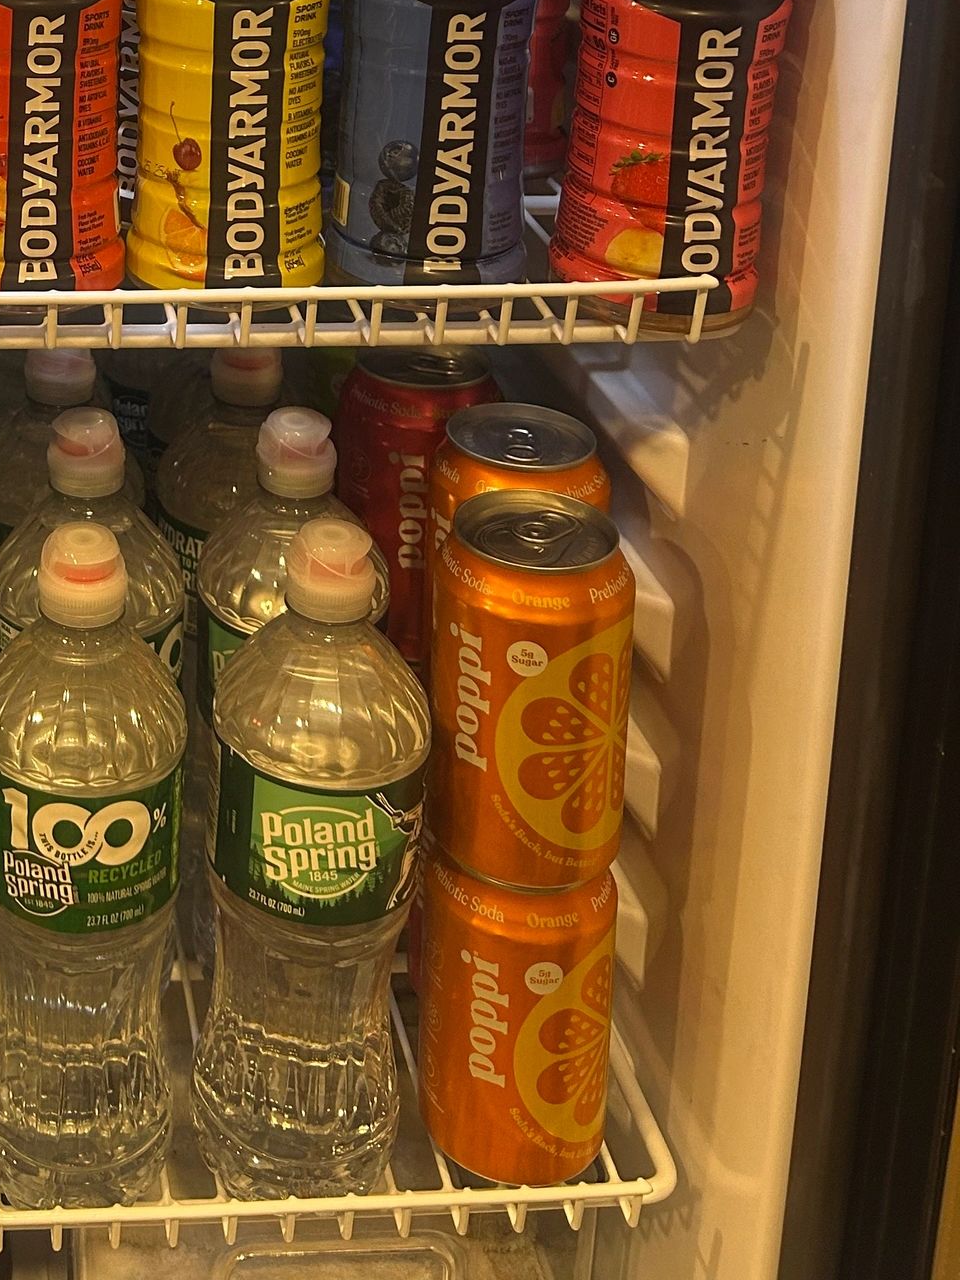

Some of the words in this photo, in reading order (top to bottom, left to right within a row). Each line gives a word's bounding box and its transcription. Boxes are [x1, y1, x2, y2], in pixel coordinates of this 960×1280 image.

[18, 14, 66, 285] BODYARMOR
[223, 6, 275, 281] BODYARMOR
[681, 26, 743, 275] ODYARMOR
[390, 451, 429, 569] poppi
[512, 588, 571, 610] Orange
[511, 656, 544, 668] Sugar
[450, 622, 491, 771] poppi
[1, 787, 167, 867] 100%
[260, 808, 375, 845] Poland
[3, 850, 72, 884] Poland
[88, 849, 162, 884] RECYCLED
[262, 839, 377, 881] Spring
[308, 871, 338, 882] 1845
[5, 874, 75, 905] Spring
[469, 896, 505, 923] Soda
[526, 911, 580, 929] Orange
[529, 976, 561, 985] Sugar
[461, 948, 510, 1088] poppi
